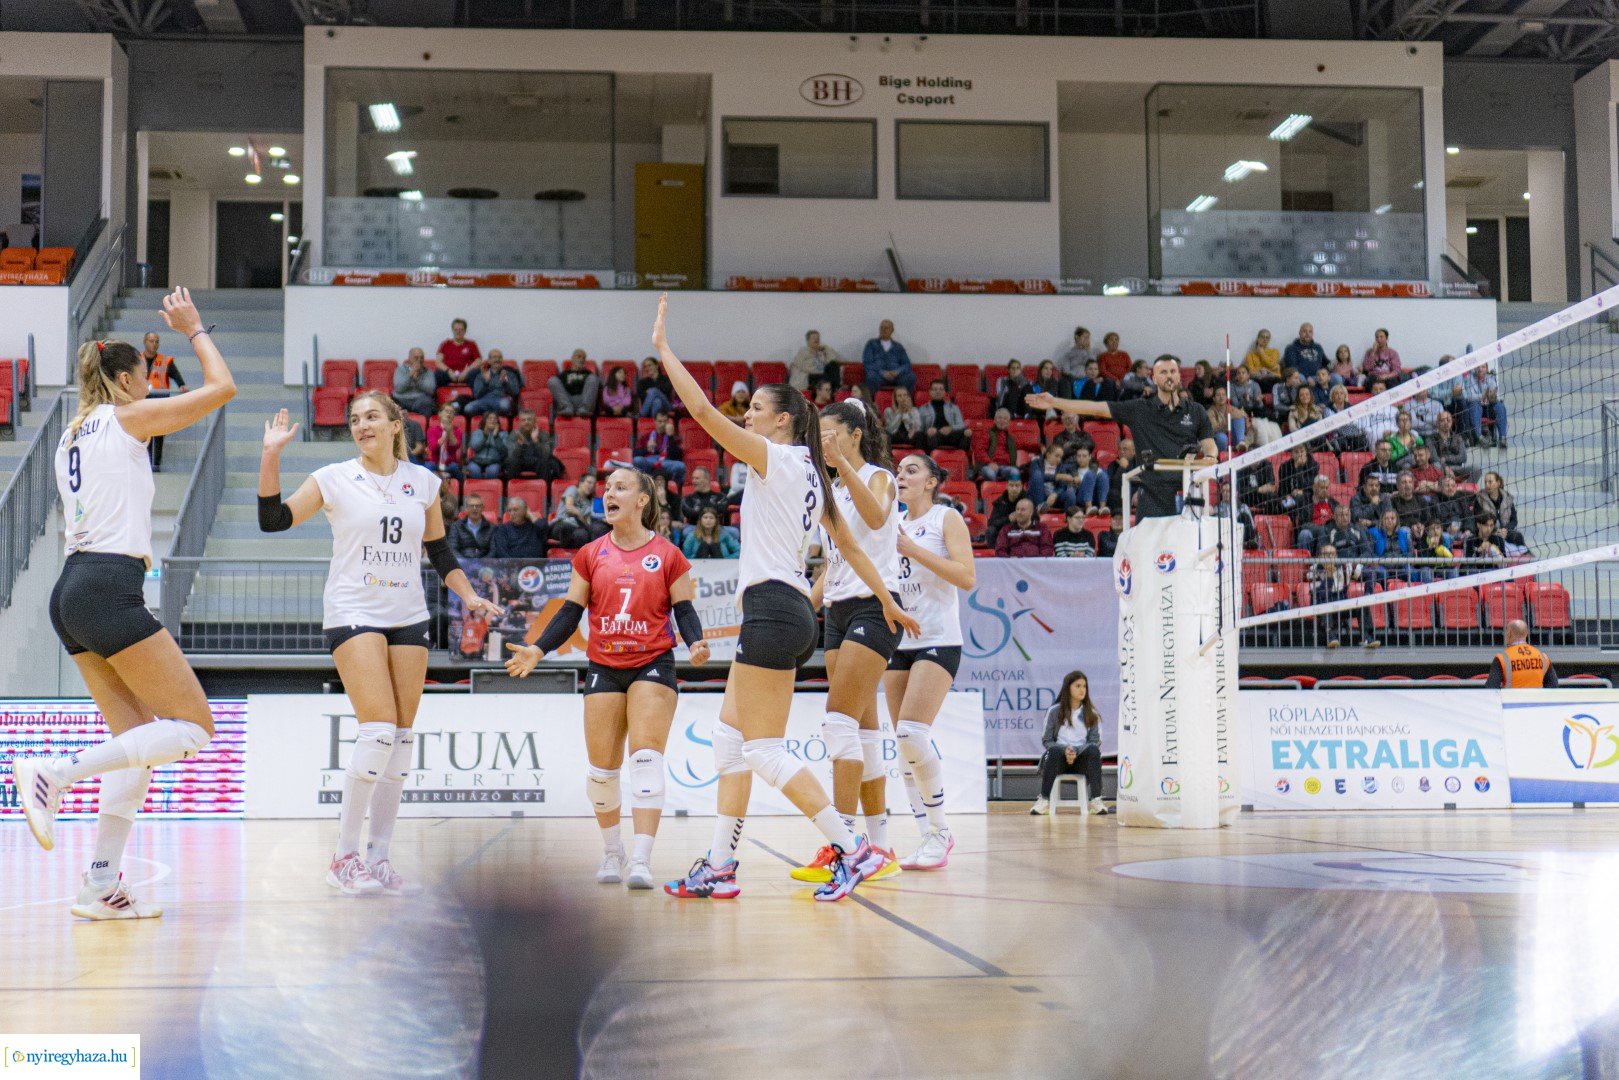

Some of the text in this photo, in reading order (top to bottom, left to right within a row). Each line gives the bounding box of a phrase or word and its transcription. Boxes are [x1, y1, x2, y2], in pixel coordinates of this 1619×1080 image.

[812, 79, 852, 101] BH
[878, 75, 972, 90] Bige Holding
[896, 93, 955, 106] Csoport
[68, 445, 81, 493] 9
[803, 490, 817, 532] 3
[379, 516, 403, 545] 13
[600, 616, 648, 633] FATUM
[1517, 646, 1532, 656] 45
[591, 673, 599, 688] 7
[970, 669, 1025, 681] MAGYAR
[0, 712, 88, 726] birodalom
[1269, 704, 1359, 722] RÖPLABDA
[1270, 723, 1411, 736] NŐI NEMZETI BAJNOKSÁG
[320, 713, 544, 772] FTUM
[1272, 738, 1489, 770] EXTRALIGA
[322, 773, 544, 787] PPERTY
[321, 789, 543, 802] INNBERUHÁZÓ KFT
